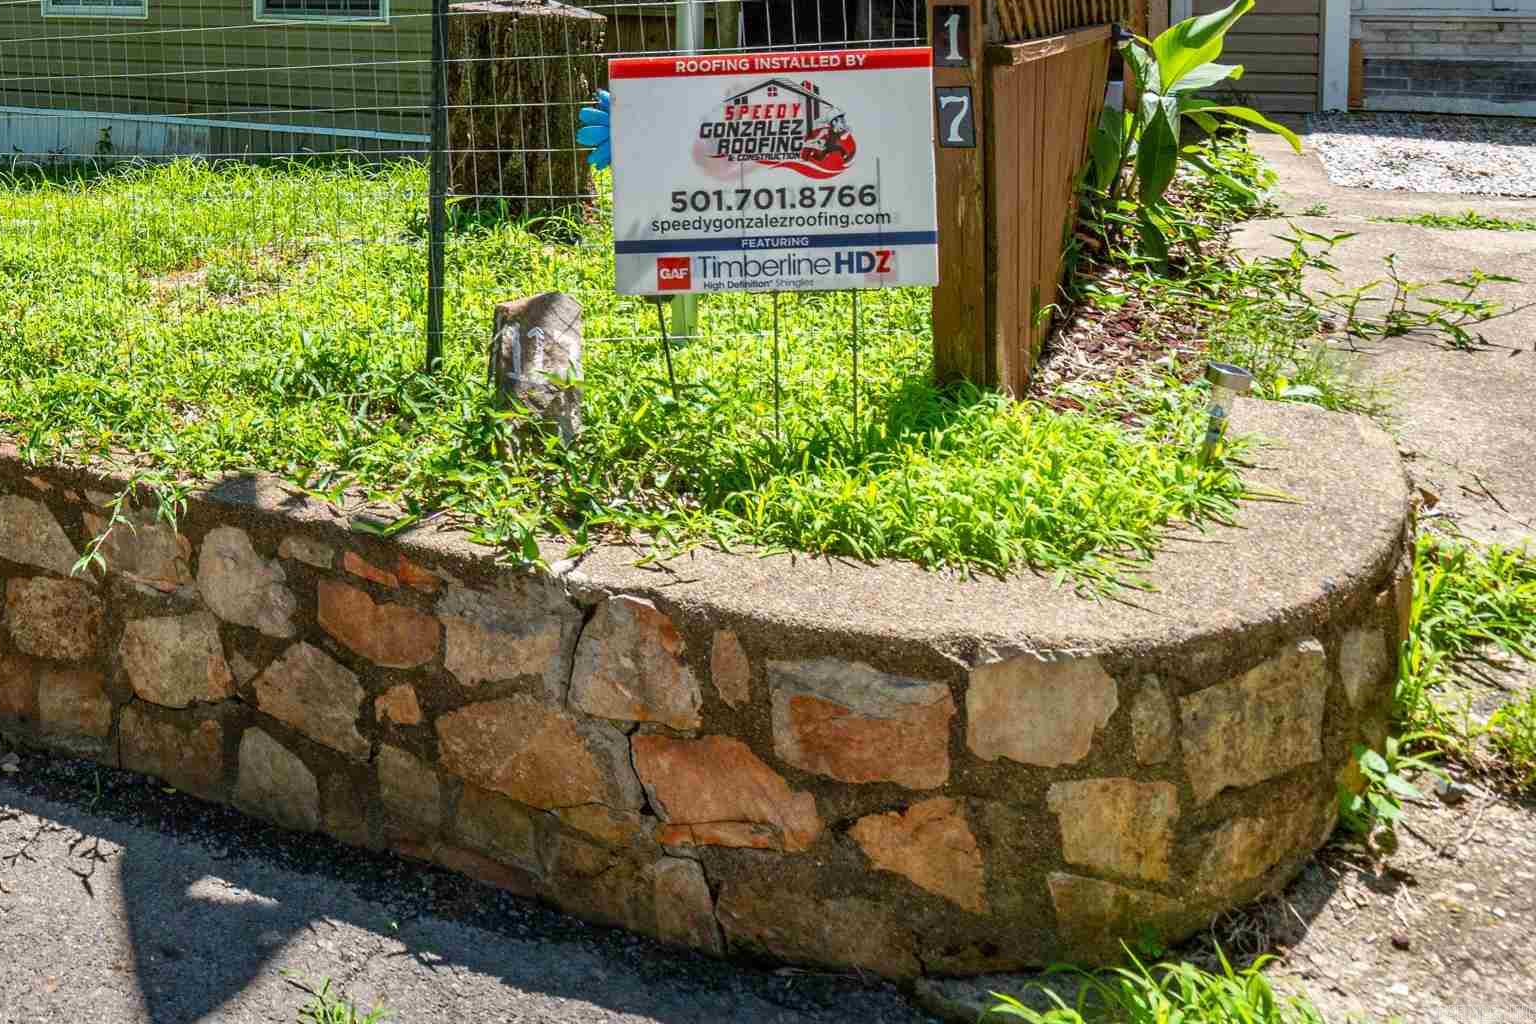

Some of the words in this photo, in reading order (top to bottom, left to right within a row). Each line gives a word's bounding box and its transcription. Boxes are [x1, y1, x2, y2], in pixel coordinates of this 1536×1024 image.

[675, 58, 751, 73] ROOFING
[754, 55, 841, 70] INSTALLED
[845, 54, 866, 67] BY
[725, 103, 801, 121] SPEEDY
[699, 119, 804, 139] GONZALEZ
[717, 136, 803, 155] ROOFING
[737, 152, 800, 162] CONSTRUCTION
[670, 184, 877, 213] 501.701.8766
[651, 210, 891, 233] speedygonzalezroofing.com
[741, 236, 809, 249] FEATURING
[698, 254, 831, 278] Timberline
[835, 249, 893, 274] HDZ
[659, 267, 689, 280] GAF
[703, 280, 726, 291] High
